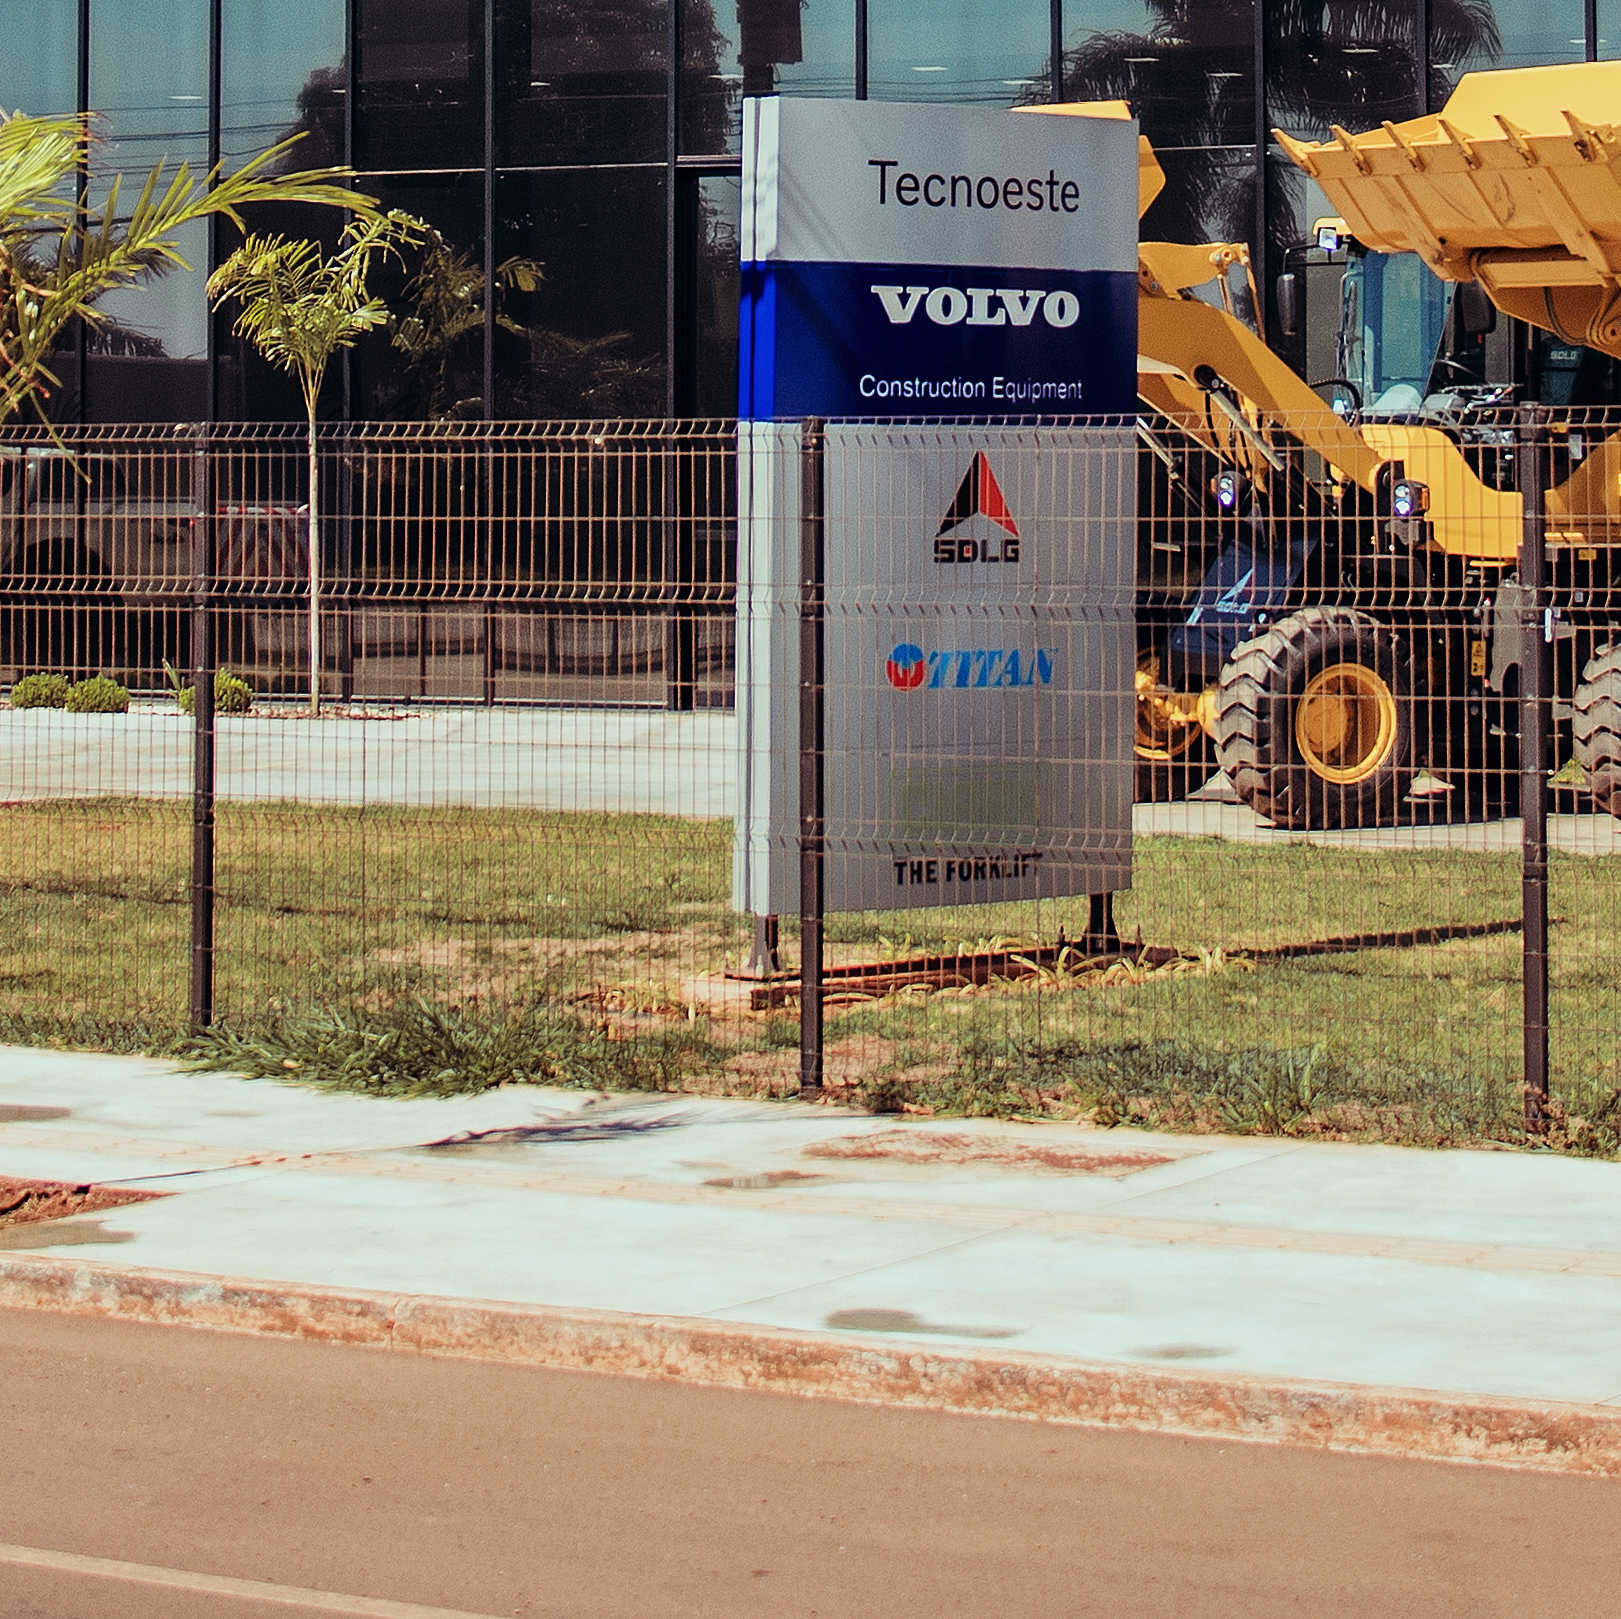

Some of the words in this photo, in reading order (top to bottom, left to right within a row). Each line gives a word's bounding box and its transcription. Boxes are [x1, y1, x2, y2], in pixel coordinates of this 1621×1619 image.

[868, 159, 1080, 213] Tecnoeste
[870, 285, 1080, 328] VOLVO
[859, 374, 986, 399] Construction
[992, 376, 1082, 403] Equipment
[933, 539, 1020, 563] SDLG
[926, 647, 1059, 690] TITAN
[893, 859, 938, 885] THE
[945, 852, 1043, 882] FORKLIFT
